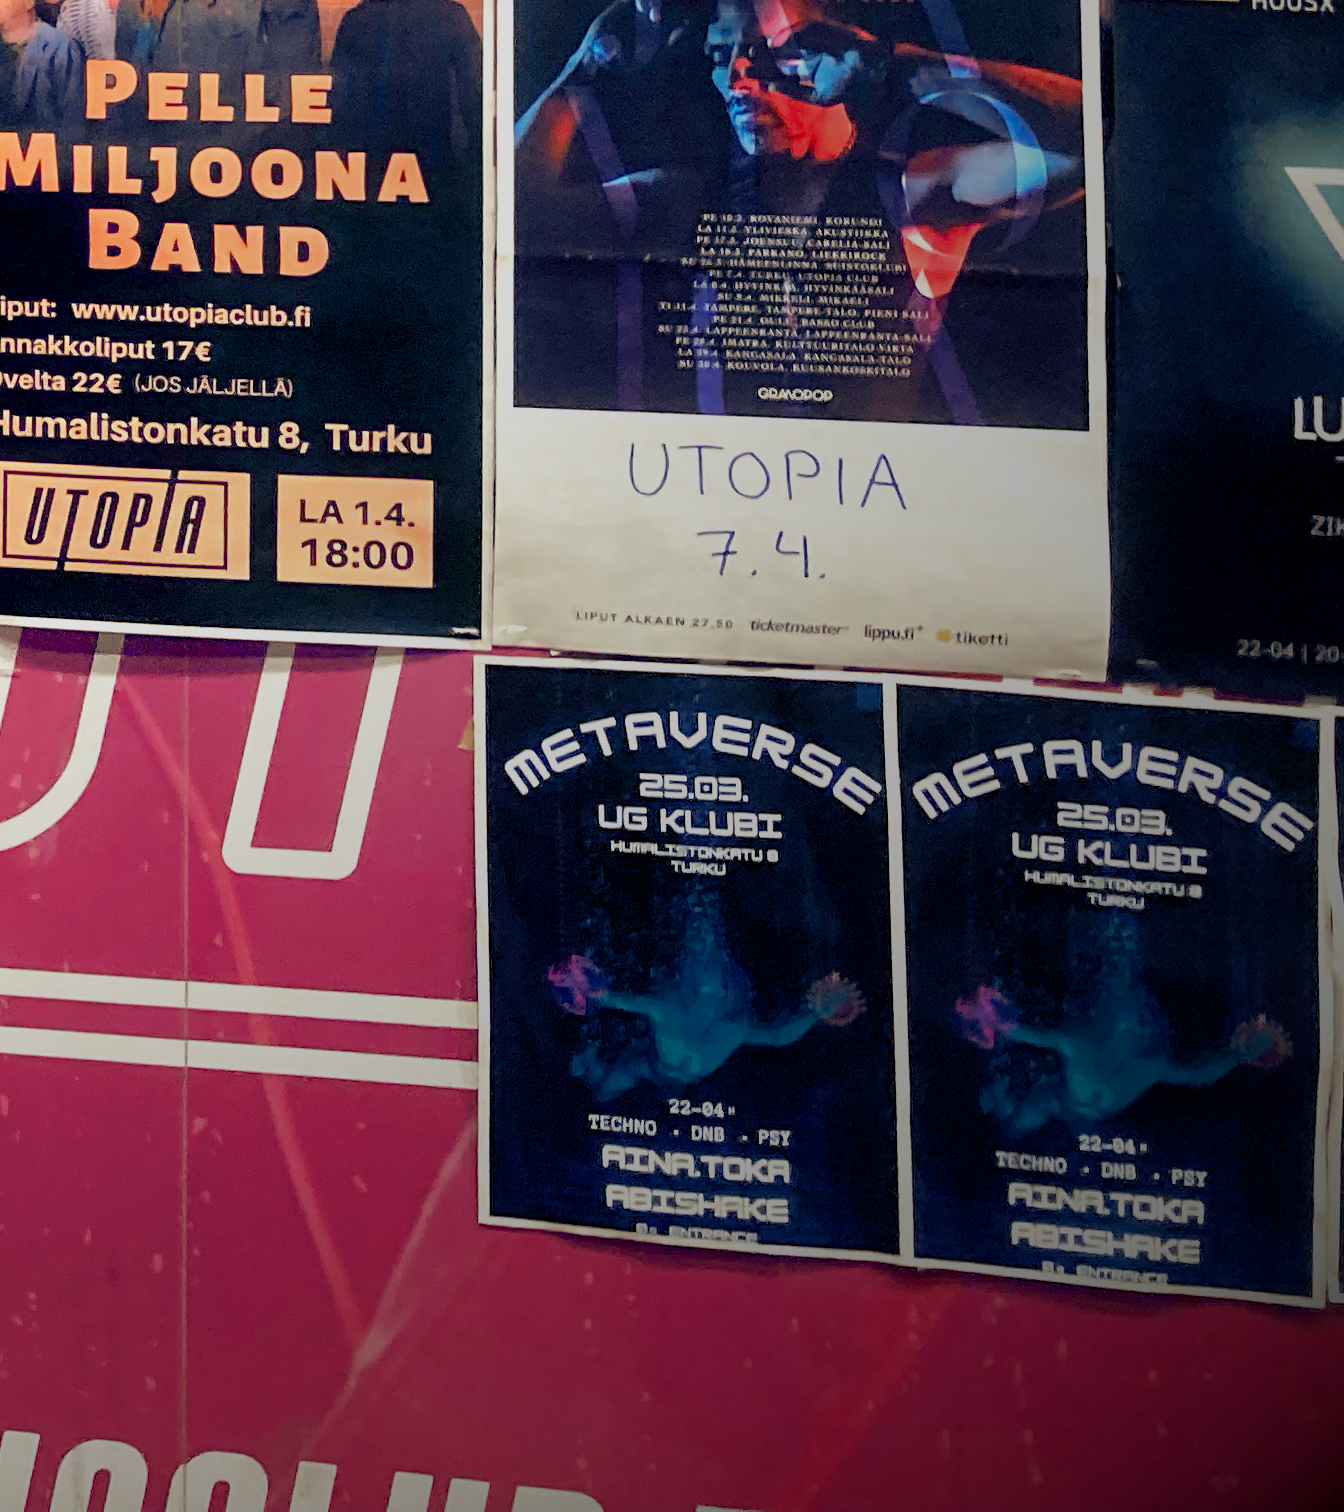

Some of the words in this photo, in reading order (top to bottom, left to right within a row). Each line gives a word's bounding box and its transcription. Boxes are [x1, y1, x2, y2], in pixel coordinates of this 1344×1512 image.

[84, 59, 334, 124] PELLE
[87, 208, 330, 277] BAND
[71, 301, 312, 329] www.utopiaclub.fi
[162, 340, 212, 363] 17€
[72, 371, 122, 394] 22€
[135, 371, 182, 394] (JOS
[185, 374, 294, 400] JÄLJELLÄ)
[277, 420, 310, 455] 8,
[325, 422, 433, 455] Turku
[628, 443, 908, 510] UTOPIA
[23, 471, 208, 571] UTOPIA
[298, 498, 344, 526] LA
[353, 501, 416, 529] 1.4.
[300, 538, 415, 572] 18:00
[696, 529, 827, 580] 7.4.
[573, 609, 618, 624] LIPUT
[623, 613, 686, 628] ALKAEN
[955, 630, 1010, 648] tiketti
[503, 710, 883, 816] METAVERSE
[638, 772, 750, 803] 25.03.
[912, 739, 1315, 854] METAVERSE
[598, 803, 648, 832] UG
[659, 807, 783, 839] KLUBI
[1056, 801, 1174, 837] 25.03.
[610, 838, 764, 862] HUMALISTONKATU
[1011, 831, 1065, 863] UG
[1077, 838, 1208, 875] KLUBI
[670, 859, 727, 877] TURKU
[1024, 868, 1186, 898] HUMALISTONKATU
[1086, 891, 1146, 911] TURKU
[587, 1113, 658, 1138] TECHNO
[690, 1123, 726, 1144] DNB
[757, 1128, 793, 1148] PSY
[601, 1143, 793, 1185] AINA.TOKA
[994, 1149, 1069, 1176] TECHNO
[1100, 1162, 1138, 1182] DNB
[1170, 1168, 1209, 1188] PSY
[604, 1182, 790, 1225] ABISHAKE
[1010, 1221, 1201, 1265] ABISHAKE
